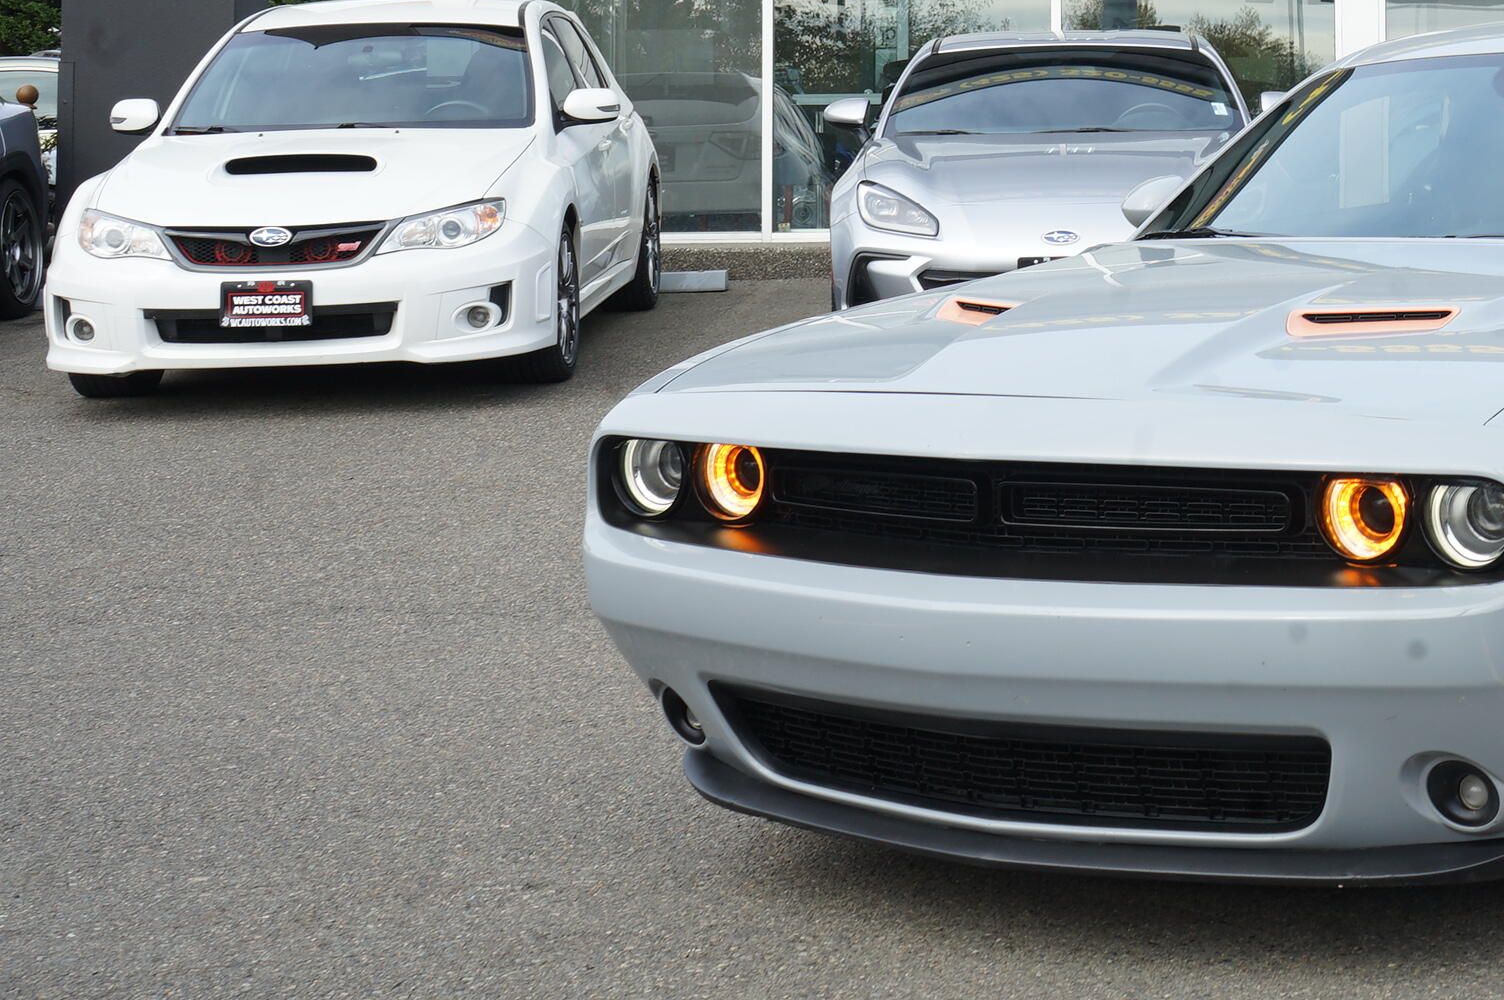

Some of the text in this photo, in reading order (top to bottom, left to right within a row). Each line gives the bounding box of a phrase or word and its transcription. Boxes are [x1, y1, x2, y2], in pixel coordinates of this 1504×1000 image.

[232, 295, 302, 305] WEST COAST
[232, 304, 302, 315] AUTOWORKS
